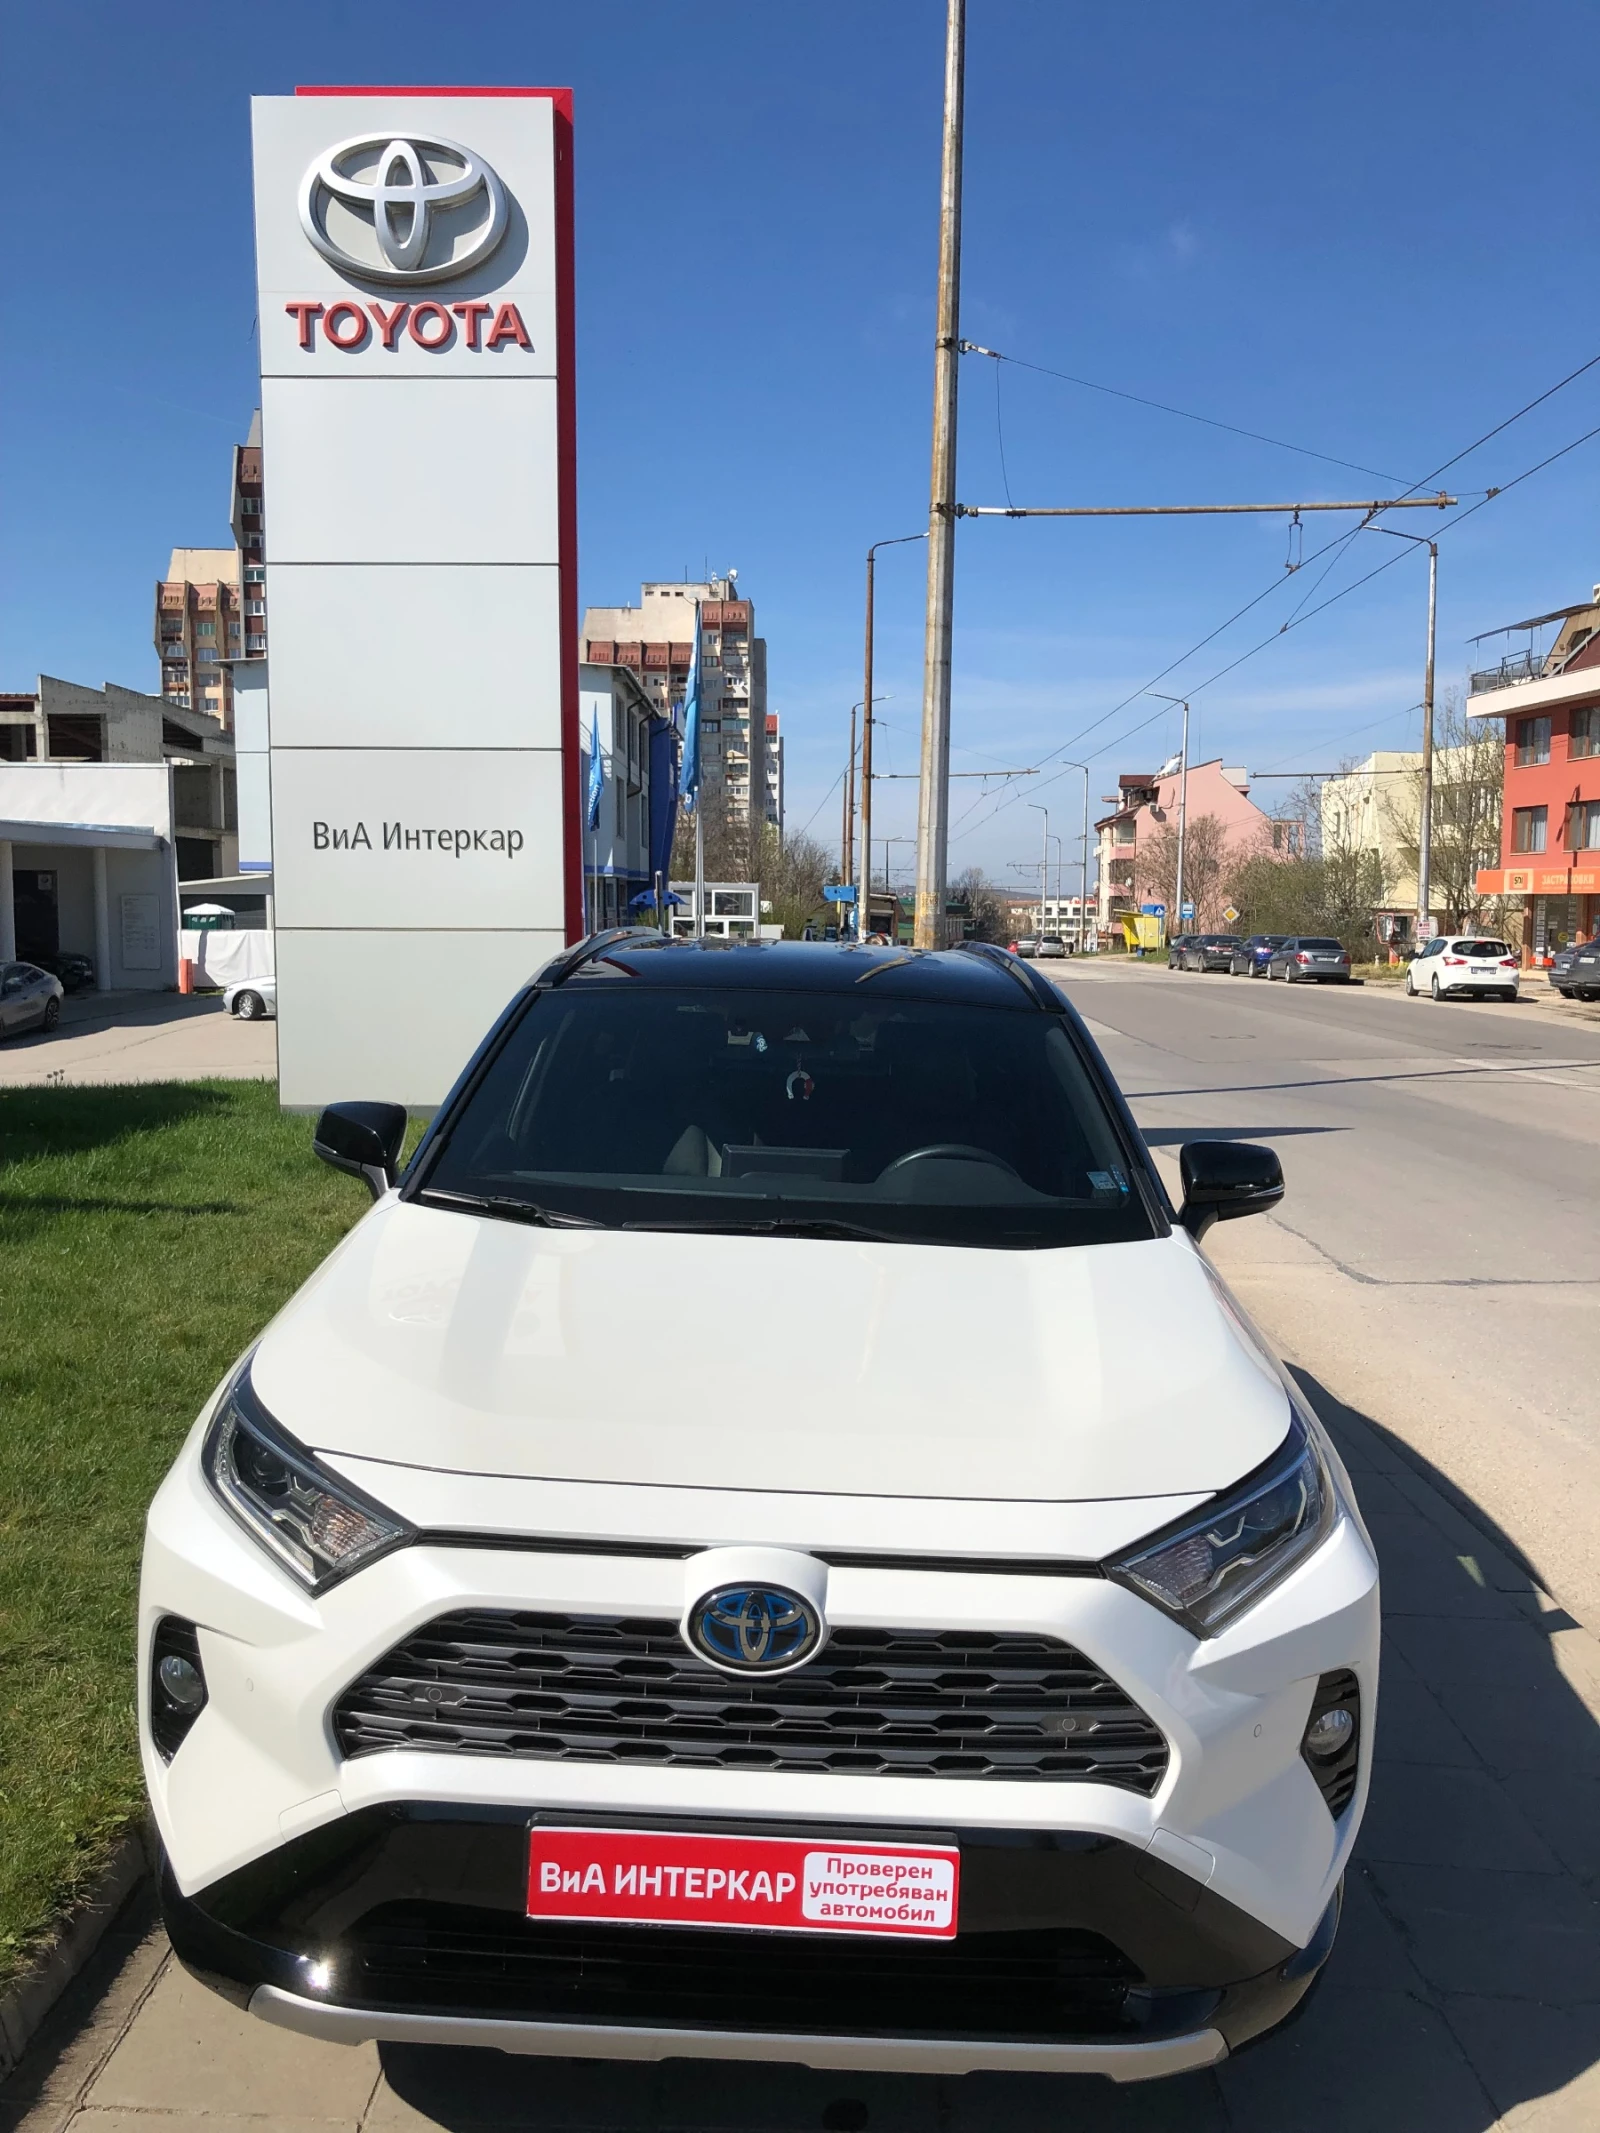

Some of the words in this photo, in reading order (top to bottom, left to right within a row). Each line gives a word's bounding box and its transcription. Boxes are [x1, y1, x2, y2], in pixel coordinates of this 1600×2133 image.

[285, 301, 532, 348] TOYOTA
[313, 821, 373, 850] ВиА
[383, 821, 524, 859] Интеркар
[1541, 874, 1595, 885] ЗАСТРАОВКИ
[826, 1857, 933, 1881] Проверен
[539, 1861, 607, 1895] ВиА
[614, 1865, 796, 1903] ИНТЕРКАР
[808, 1881, 948, 1902] употребяван
[820, 1903, 935, 1922] автомобил
